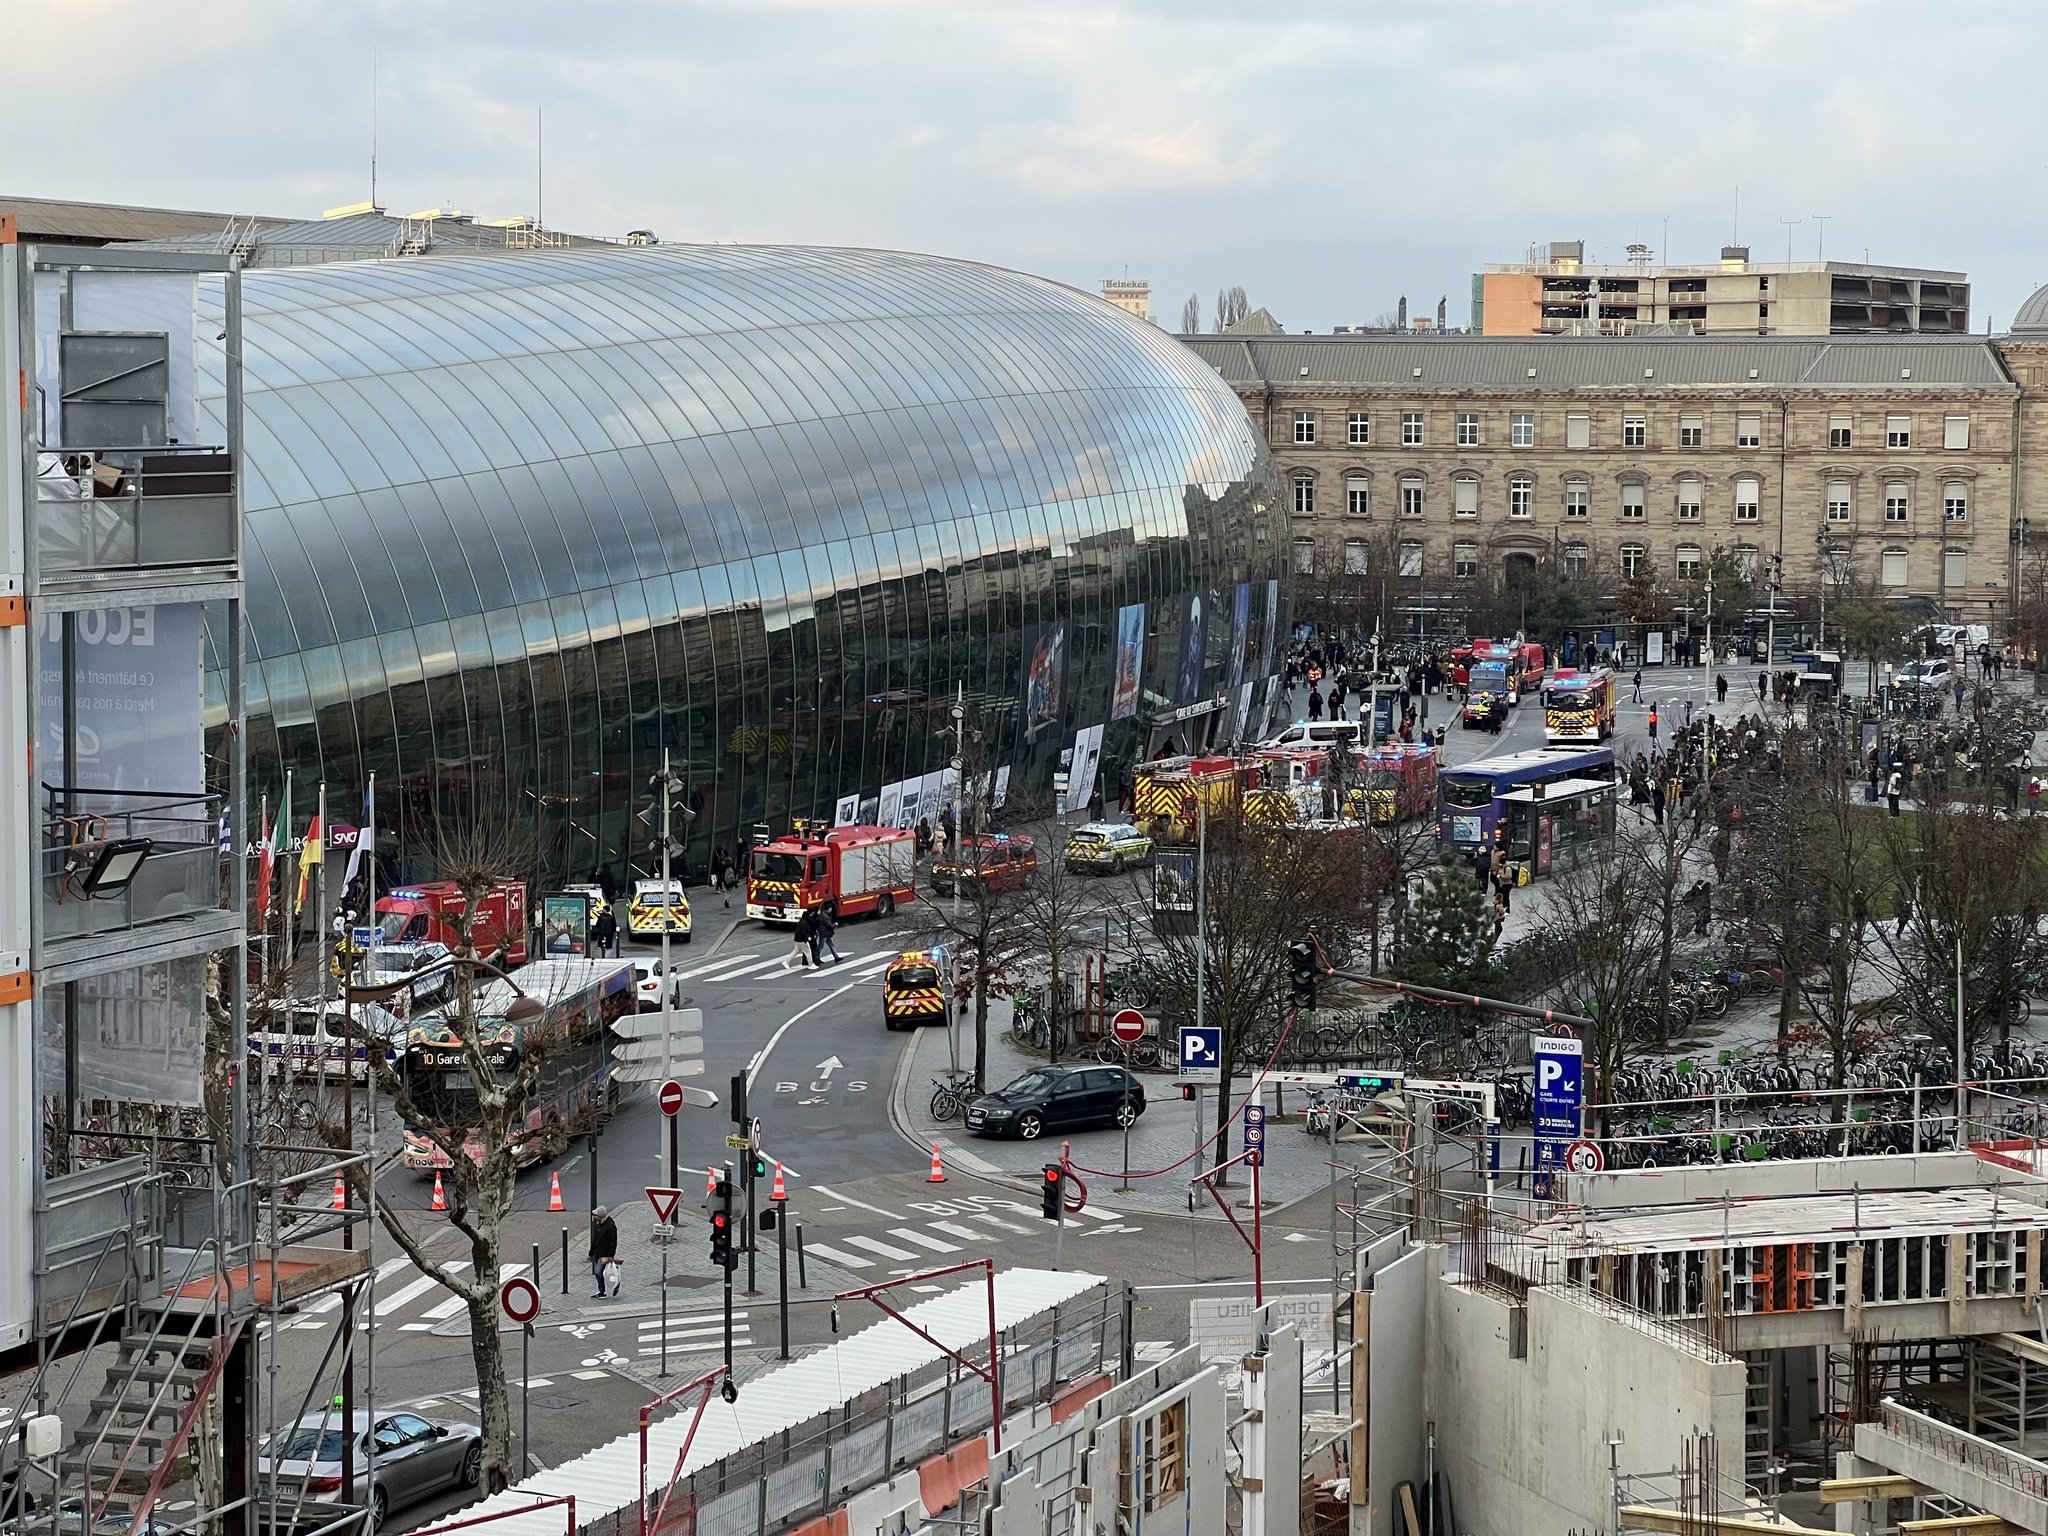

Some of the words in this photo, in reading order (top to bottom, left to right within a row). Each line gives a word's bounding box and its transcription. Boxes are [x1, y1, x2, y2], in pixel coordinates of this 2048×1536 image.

[1106, 280, 1148, 288] Heineken
[1186, 1035, 1205, 1060] P
[1540, 1042, 1576, 1051] INDIGO
[423, 1053, 434, 1065] 10
[437, 1053, 460, 1065] Gare
[1540, 1059, 1563, 1090] P
[775, 1081, 869, 1093] BUS
[1340, 1077, 1346, 1085] P
[906, 1195, 1021, 1217] BUS
